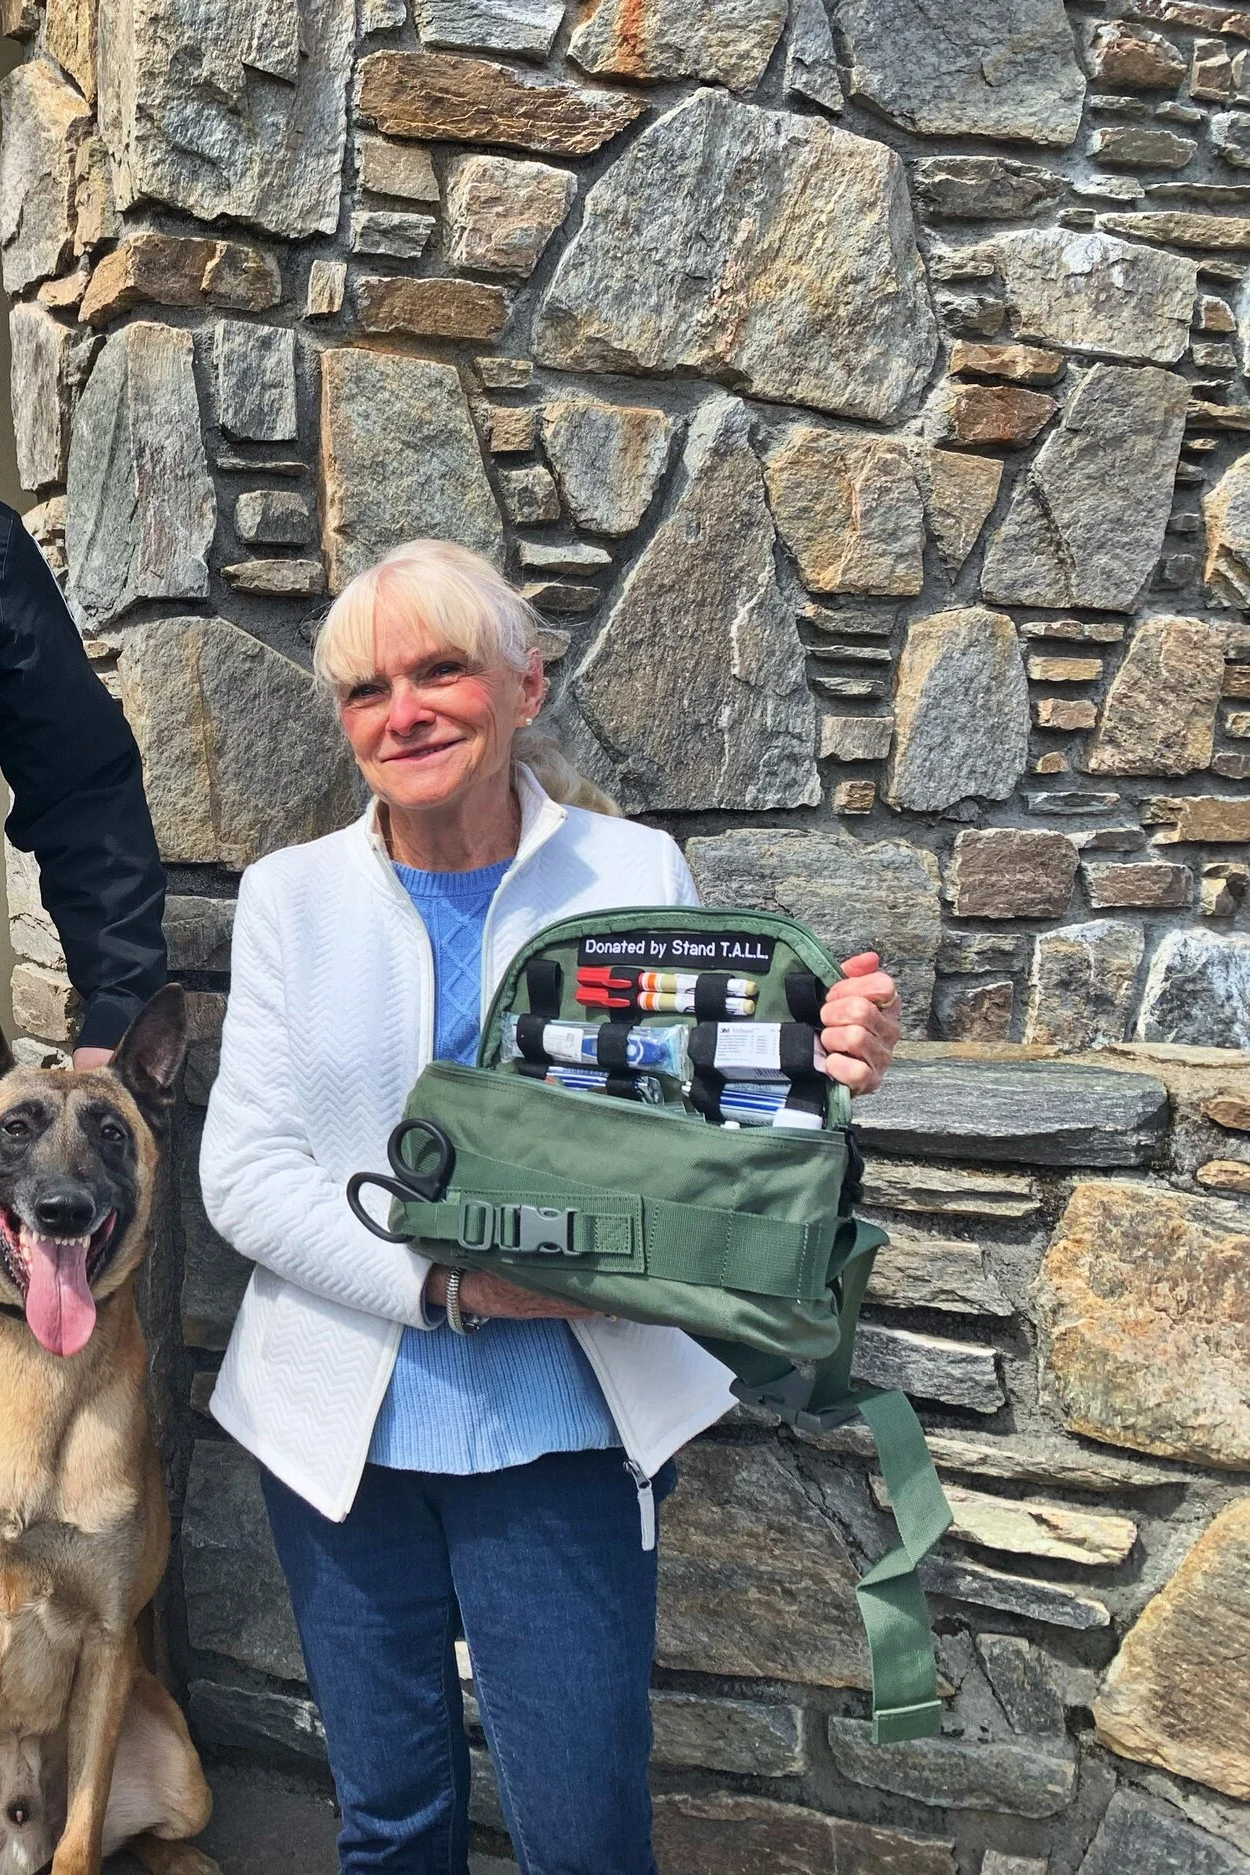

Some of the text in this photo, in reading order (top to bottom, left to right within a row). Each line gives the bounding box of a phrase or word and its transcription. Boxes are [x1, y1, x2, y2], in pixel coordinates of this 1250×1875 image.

[585, 939, 769, 960] Donated by Stand T.A.L.L.
